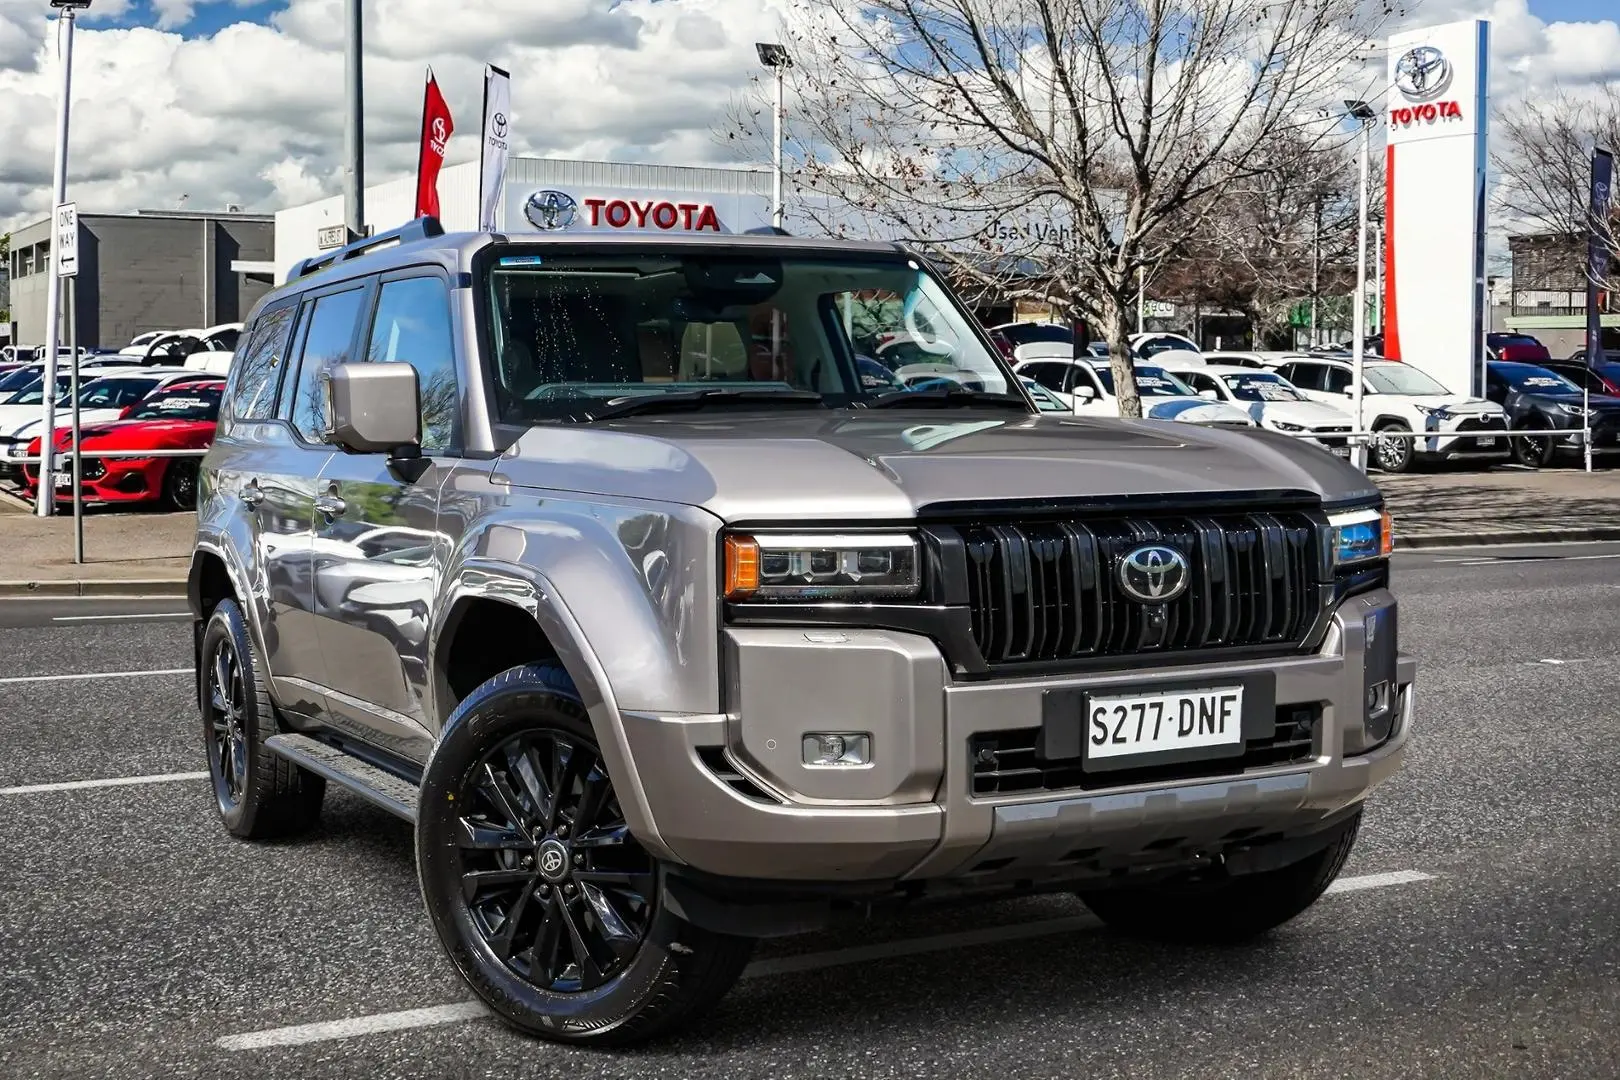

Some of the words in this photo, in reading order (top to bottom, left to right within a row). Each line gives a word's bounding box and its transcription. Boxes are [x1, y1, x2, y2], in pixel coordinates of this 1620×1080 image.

[1390, 101, 1462, 124] TOYOTA
[488, 136, 508, 150] TOYOTA
[60, 210, 74, 227] ONE
[584, 199, 720, 231] TOYOTA
[60, 232, 75, 248] WAY
